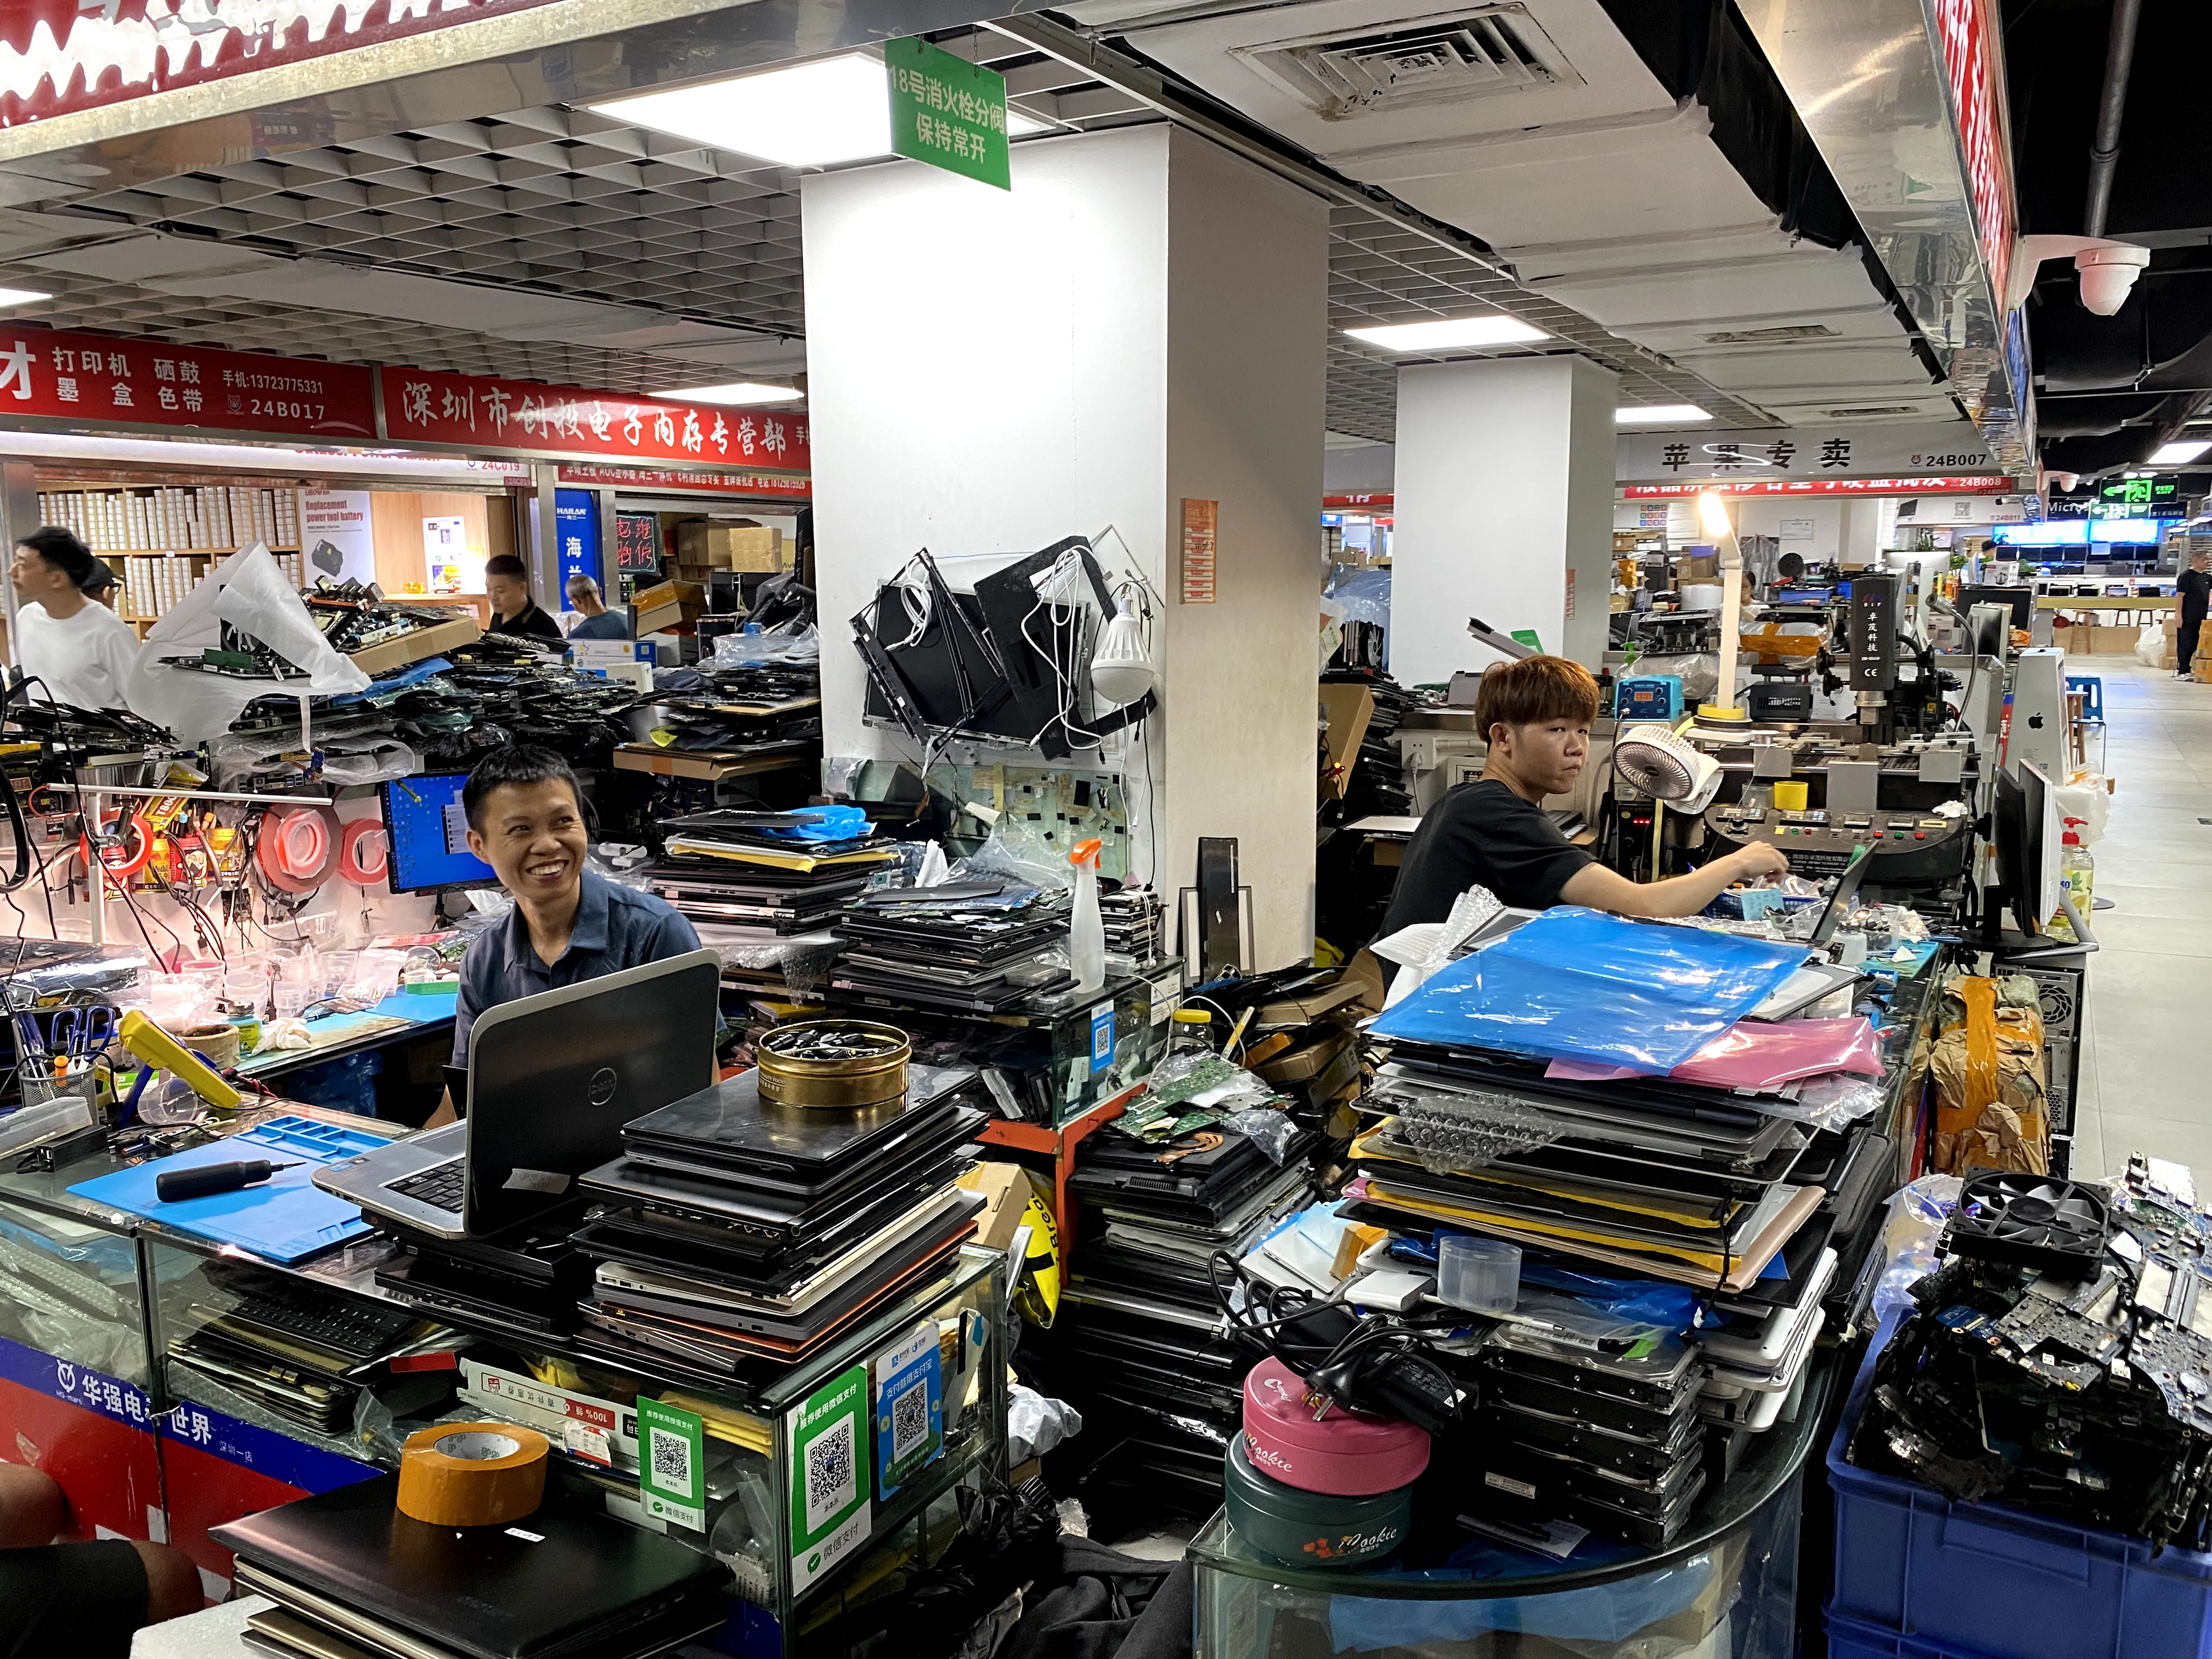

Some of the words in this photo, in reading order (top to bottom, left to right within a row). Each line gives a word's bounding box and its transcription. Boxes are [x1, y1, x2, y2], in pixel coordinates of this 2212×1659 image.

[889, 64, 1005, 134] 18号消火栓分阀
[916, 111, 986, 163] 保持常开
[52, 346, 132, 379] 打印机
[154, 358, 201, 385] 硒鼓
[223, 370, 323, 394] 手机:13723775331
[157, 388, 203, 413] 色带
[251, 399, 325, 420] 24B017
[1662, 438, 1852, 472] 苹果专卖
[1926, 454, 1987, 467] 24B007
[1960, 477, 2002, 487] 24B008
[306, 500, 347, 511] Replacement
[307, 514, 326, 523] power
[327, 512, 340, 521] tool
[340, 512, 363, 521] battery
[1867, 612, 1878, 652] 卓茂科技
[56, 1390, 82, 1405] HQ-mart
[507, 1385, 555, 1408] 寄件优惠券
[799, 1383, 857, 1431] 推荐使用微信支付
[585, 1409, 607, 1423] 100%
[646, 1409, 693, 1431] 推荐使用微信支付
[219, 1441, 253, 1464] 深圳一店
[665, 1505, 693, 1523] 微信支付
[823, 1522, 859, 1561] 微信支付
